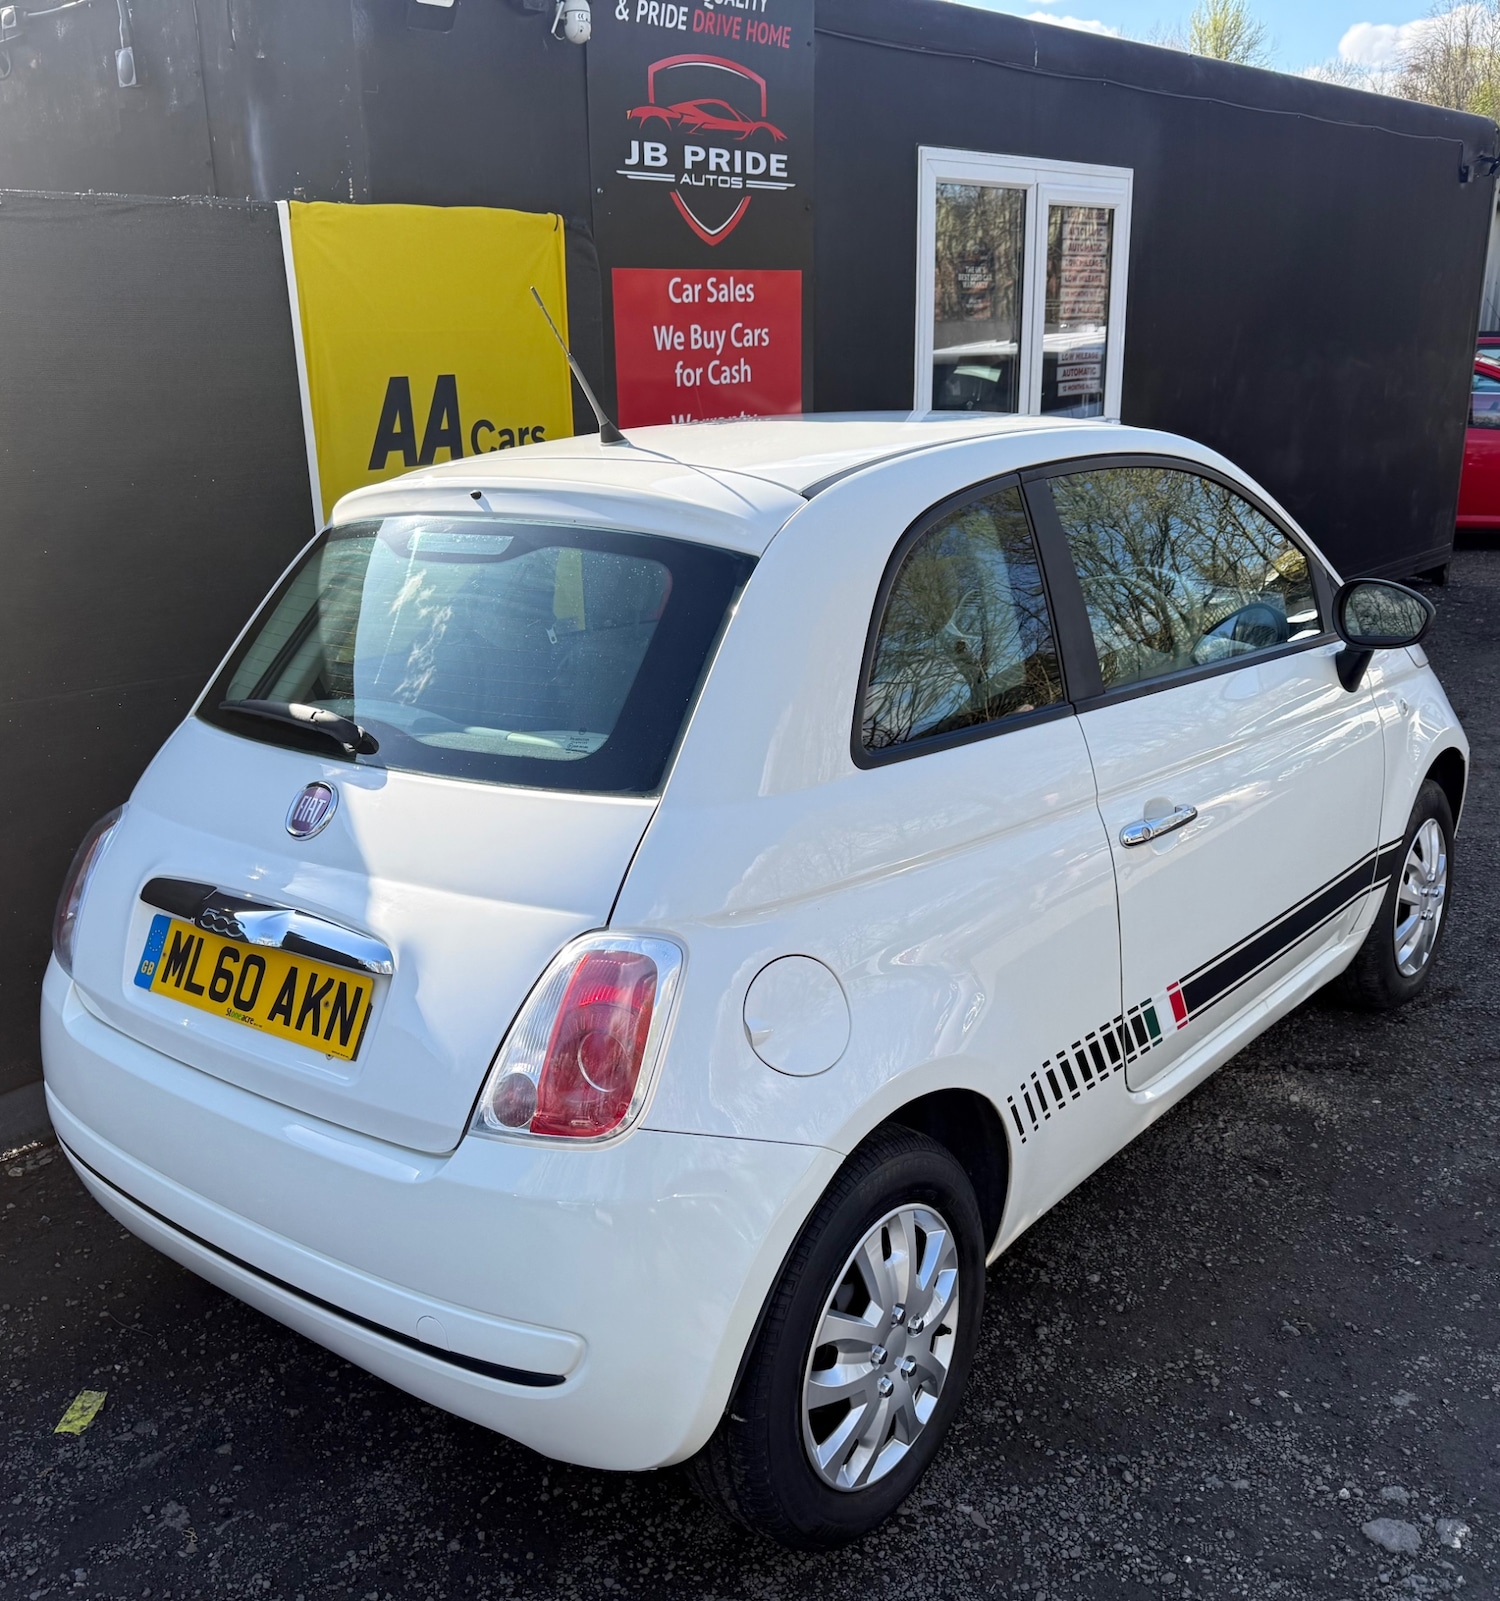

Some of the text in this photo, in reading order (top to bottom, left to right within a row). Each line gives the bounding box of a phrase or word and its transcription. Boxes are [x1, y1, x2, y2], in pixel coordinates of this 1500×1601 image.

[615, 0, 630, 22] &
[636, 0, 689, 31] PRIDE
[693, 9, 742, 40] DRIVE
[746, 19, 792, 49] HOME
[624, 140, 788, 178] JB PRIDE
[680, 173, 743, 189] AUTOS
[668, 276, 754, 303] Car Sales
[653, 322, 770, 355] We Buy Cars
[675, 357, 752, 387] for Cash
[368, 374, 546, 470] AA Cars
[293, 795, 327, 824] FIAT
[200, 907, 246, 937] 500
[141, 960, 155, 976] GB
[161, 930, 363, 1047] ML60 AKN
